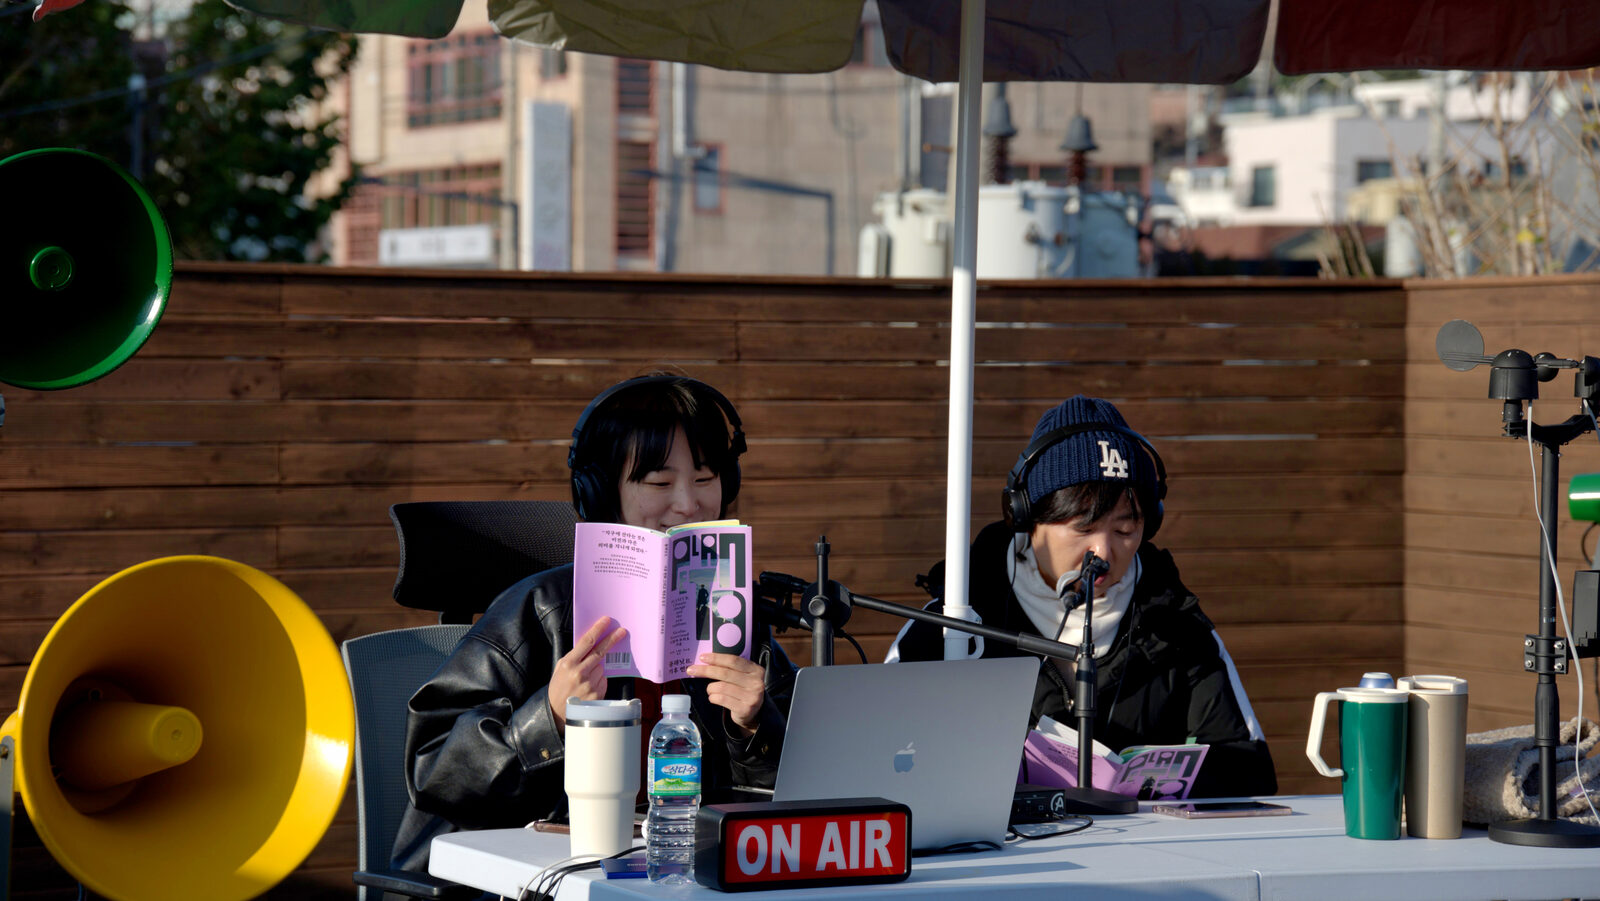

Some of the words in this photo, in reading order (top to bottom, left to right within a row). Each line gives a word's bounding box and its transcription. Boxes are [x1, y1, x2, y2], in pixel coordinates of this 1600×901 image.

[1098, 441, 1128, 478] LA
[671, 533, 746, 591] PLAN
[669, 765, 696, 774] 삼다수
[737, 824, 801, 876] ON
[815, 819, 893, 871] AIR
